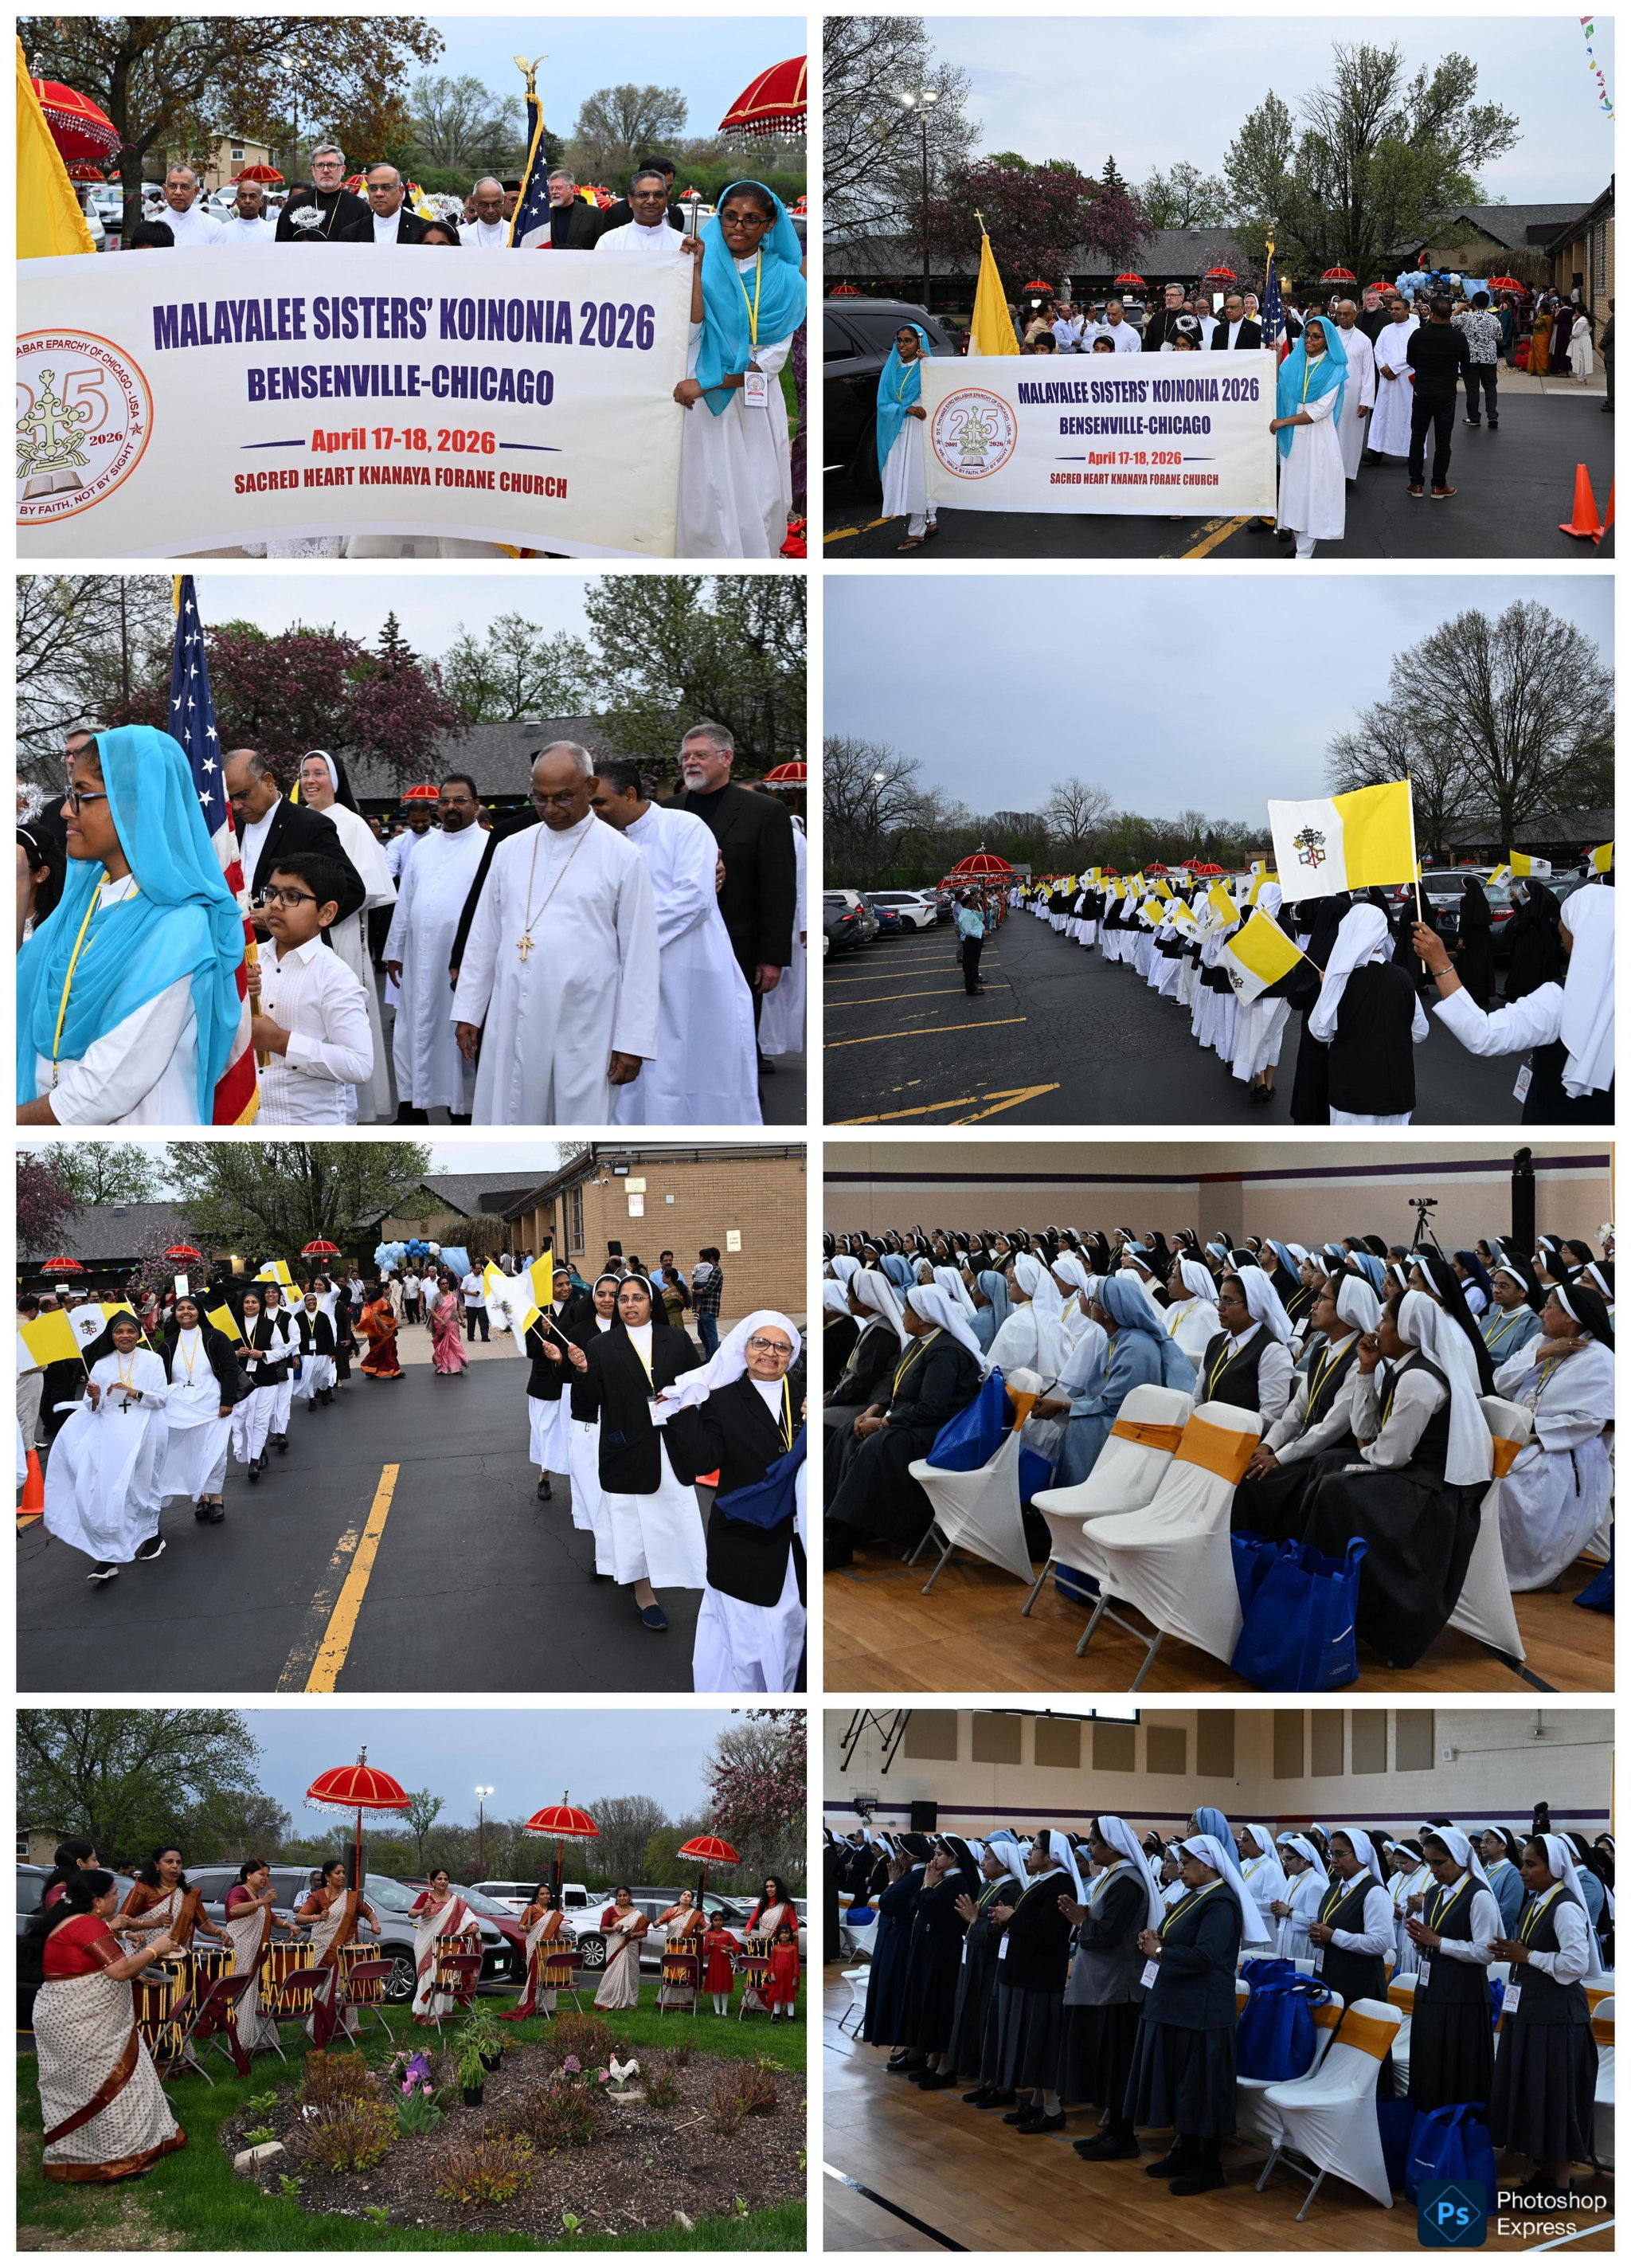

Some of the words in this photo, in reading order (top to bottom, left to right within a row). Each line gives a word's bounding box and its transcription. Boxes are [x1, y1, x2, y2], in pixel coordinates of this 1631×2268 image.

[153, 298, 306, 351] MALAYALEE
[440, 298, 573, 344] KOINONIA
[580, 301, 655, 350] 2026
[46, 339, 90, 353] EPARCHY
[90, 346, 104, 361] OF
[102, 353, 132, 390] CHICAGO
[128, 395, 139, 419] USA
[248, 364, 553, 405] BENSENVILLE-CHICAGO
[1018, 382, 1088, 404] MALAYALEE
[1152, 379, 1218, 402] KOINONIA
[1222, 378, 1259, 402] 2026
[937, 407, 948, 426] THOMAS
[953, 393, 973, 402] MALABAR
[973, 393, 992, 402] EPARCHY
[996, 402, 1010, 421] CHICAGO
[1060, 416, 1211, 434] BENSENVILLE-CHICAGO
[89, 431, 123, 446] 2026
[311, 428, 366, 453] April
[371, 428, 432, 452] 17-18,
[437, 429, 495, 454] 2026
[946, 459, 959, 472] WALK
[996, 447, 1008, 464] SIGHT
[1088, 452, 1115, 465] April
[1118, 452, 1149, 465] 17-18,
[1152, 452, 1181, 465] 2026
[20, 506, 36, 515] BY
[38, 499, 73, 515] FAITH,
[75, 488, 96, 504] NOT
[97, 475, 111, 490] BY
[111, 442, 135, 477] SIGHT
[235, 470, 299, 494] SACRED
[304, 467, 354, 487] HEART
[359, 466, 431, 485] KNANAYA
[436, 468, 495, 490] FORANE
[500, 472, 567, 499] CHURCH
[1050, 473, 1081, 484] SACRED
[1084, 473, 1109, 484] HEART
[1111, 473, 1148, 485] KNANAYA
[1150, 473, 1180, 485] FORANE
[1183, 473, 1219, 486] CHURCH
